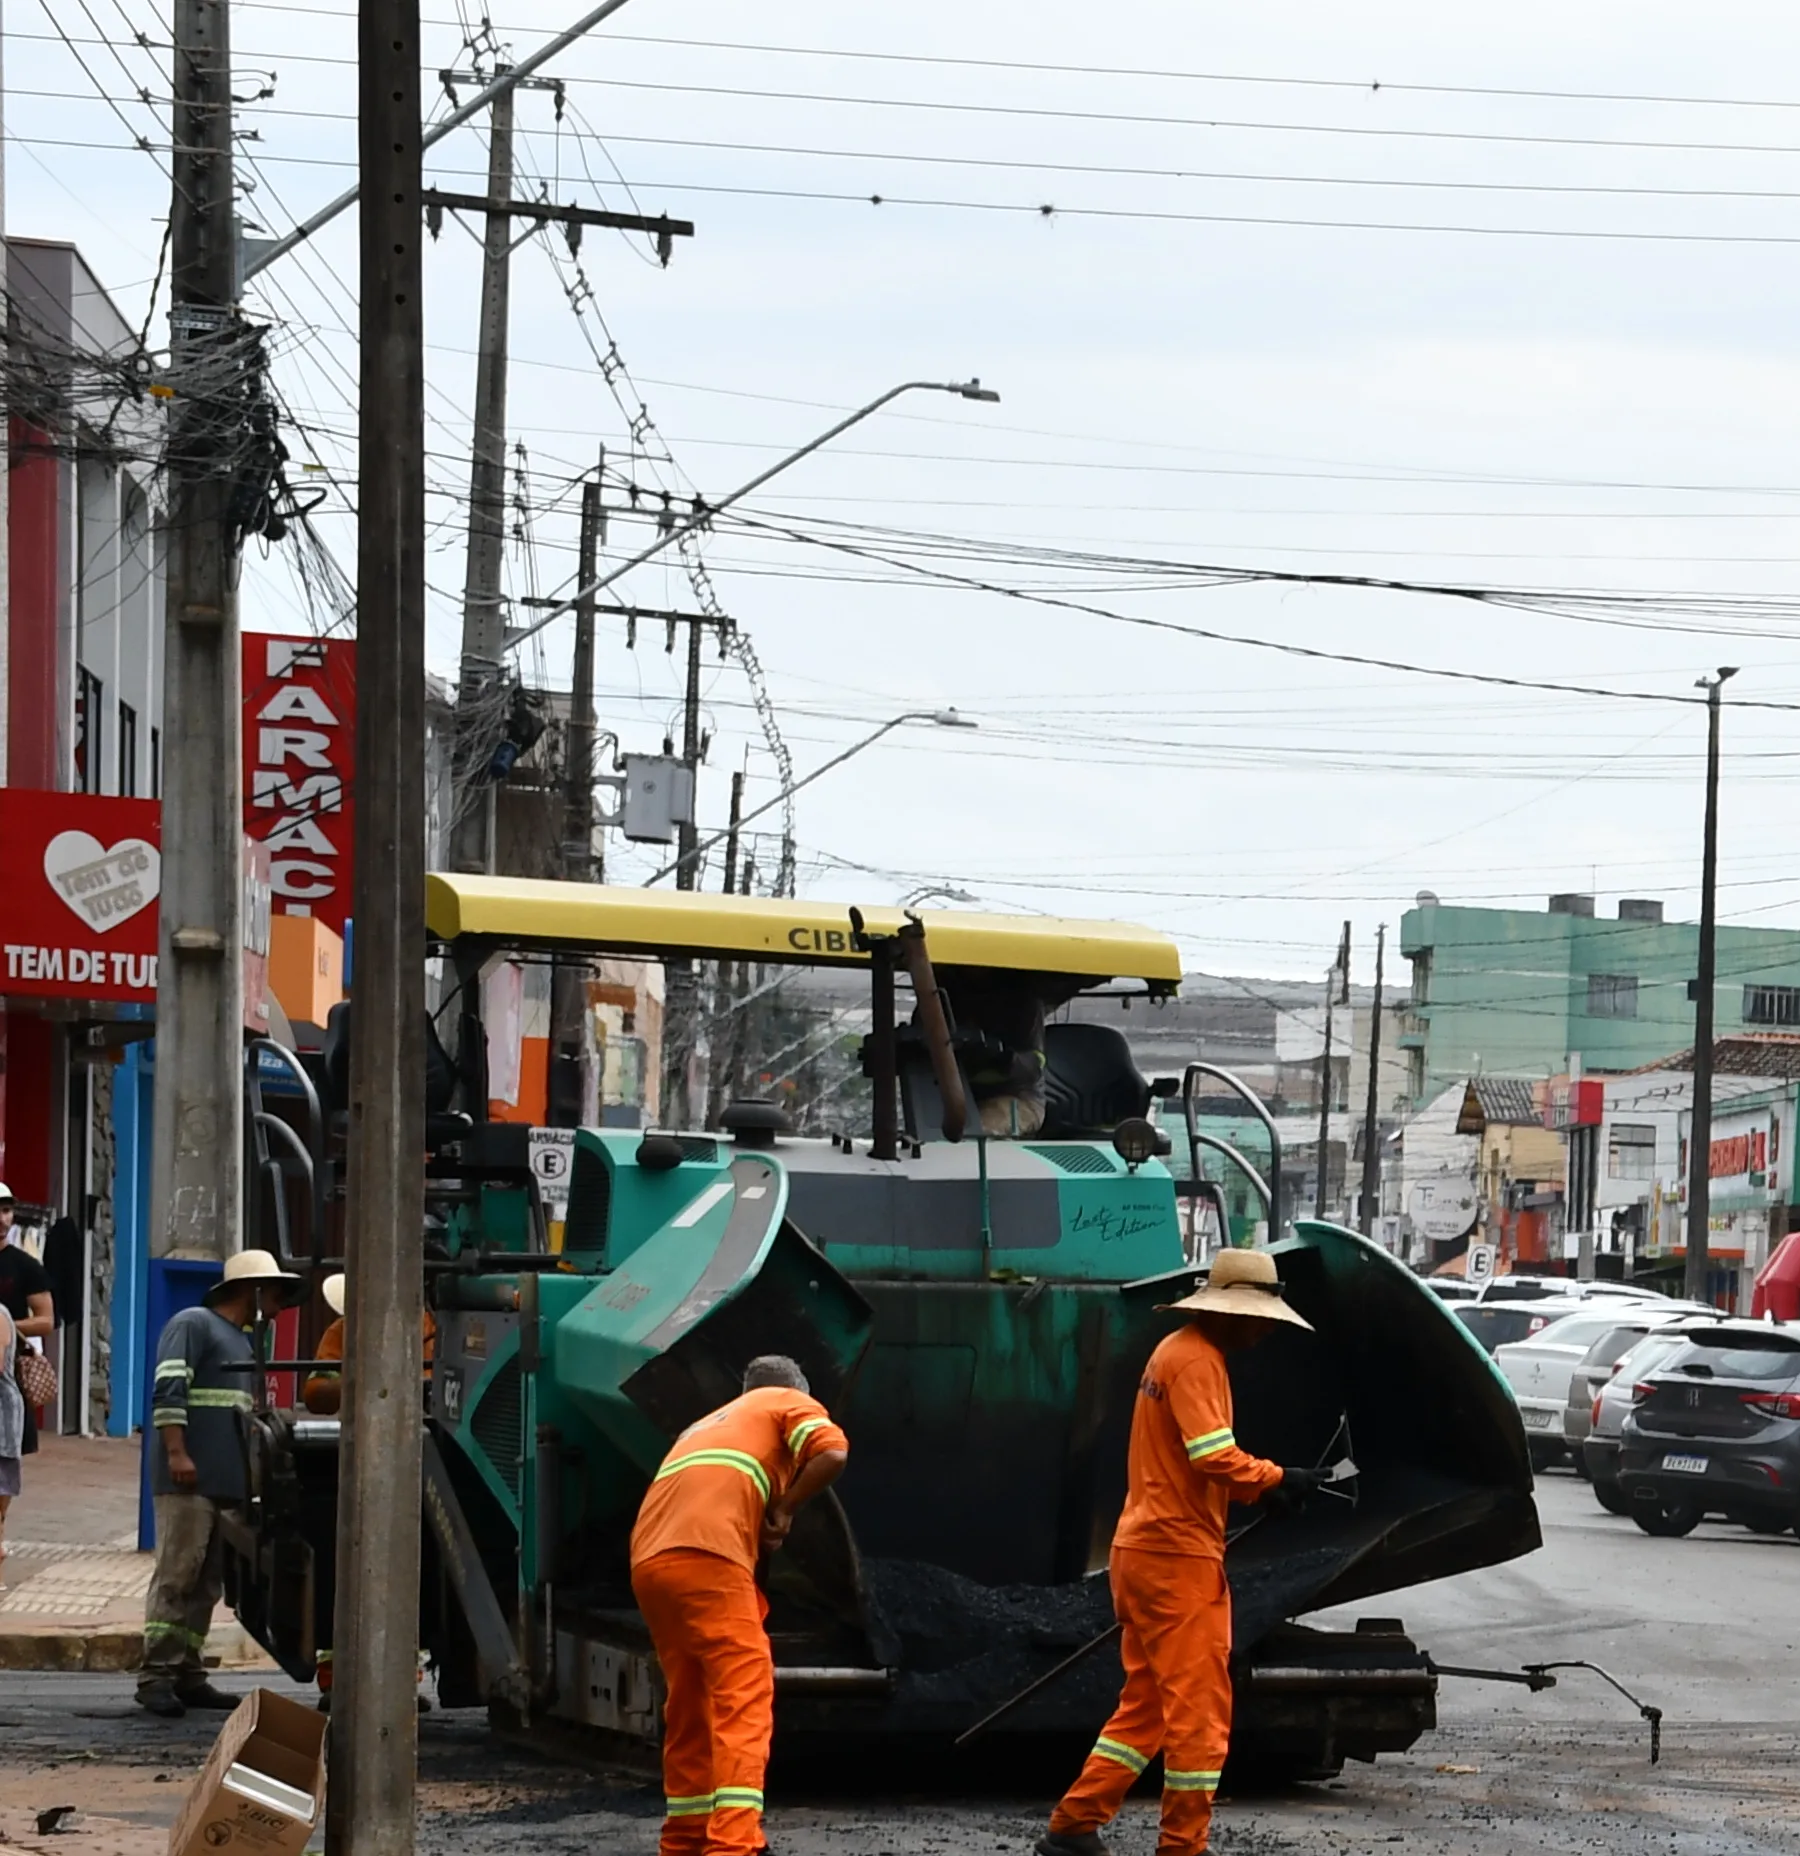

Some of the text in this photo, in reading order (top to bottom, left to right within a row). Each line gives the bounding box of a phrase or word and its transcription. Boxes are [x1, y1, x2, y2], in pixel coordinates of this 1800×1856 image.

[4, 944, 64, 981] TEM
[68, 947, 106, 984] DE
[544, 1154, 557, 1173] E
[1474, 1252, 1487, 1273] E
